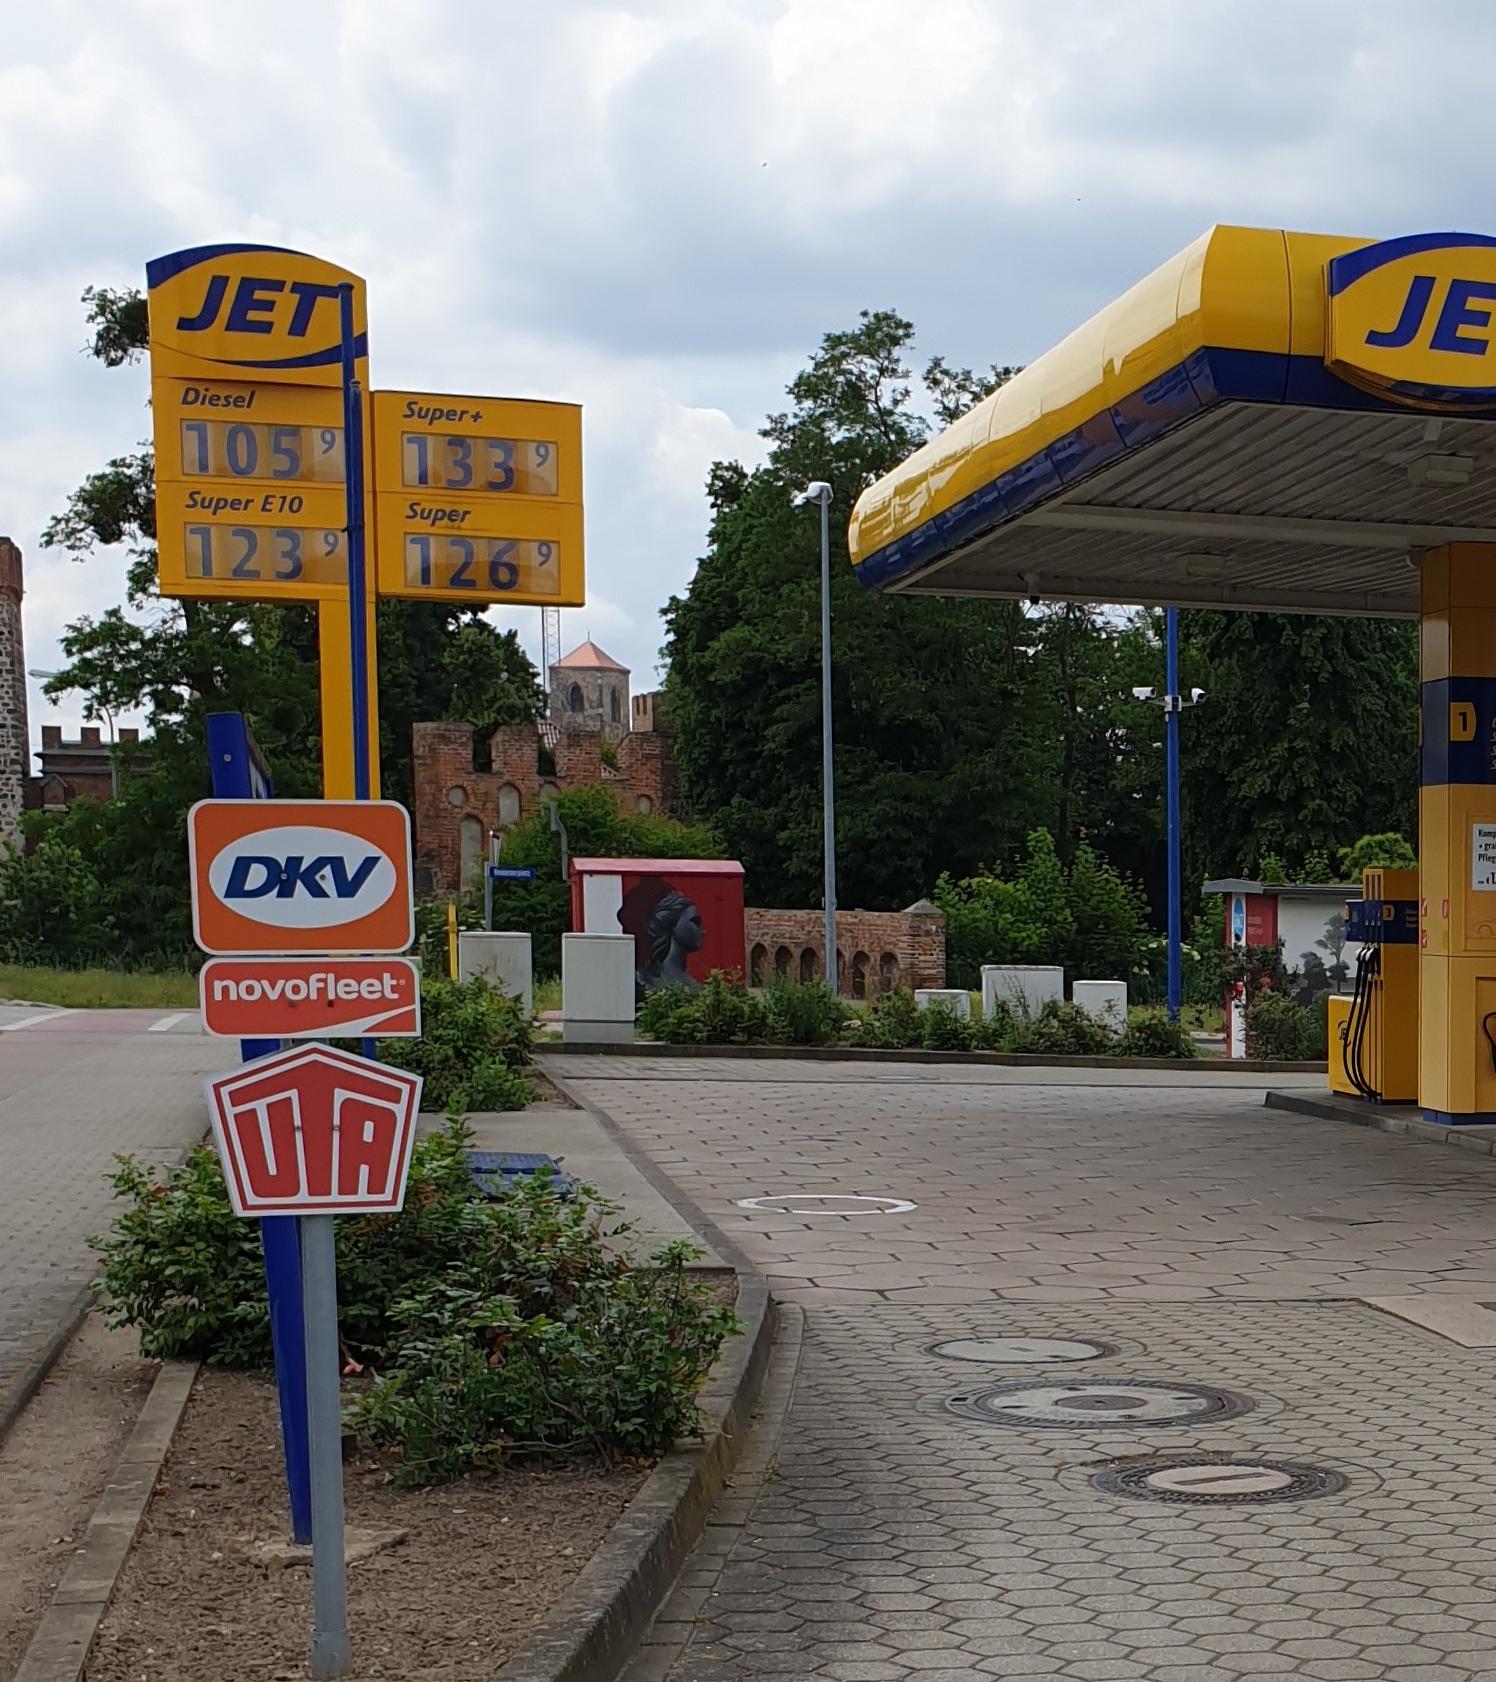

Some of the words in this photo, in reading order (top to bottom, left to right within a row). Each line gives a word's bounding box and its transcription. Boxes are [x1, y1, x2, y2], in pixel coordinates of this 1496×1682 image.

[176, 275, 341, 337] JET
[181, 387, 256, 409] Diesel
[403, 401, 483, 426] Super+
[185, 491, 254, 516] Super
[261, 495, 304, 514] E10
[405, 502, 471, 527] Super
[1458, 711, 1468, 732] 1
[224, 855, 382, 898] DKV
[213, 972, 399, 1002] novofleet
[228, 1059, 404, 1199] UTA
